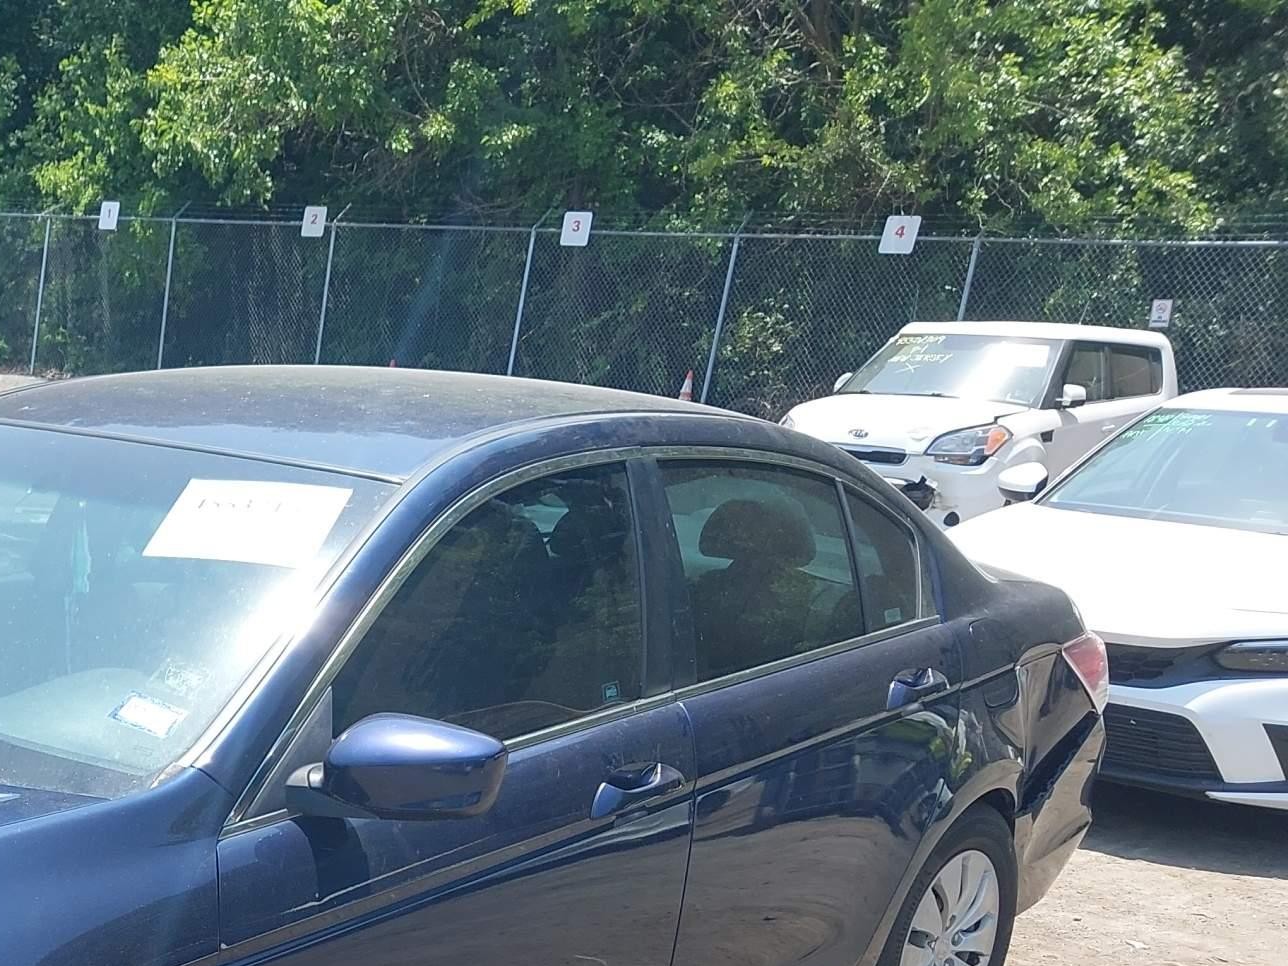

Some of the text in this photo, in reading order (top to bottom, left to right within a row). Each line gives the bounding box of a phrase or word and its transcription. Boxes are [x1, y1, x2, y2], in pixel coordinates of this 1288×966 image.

[311, 214, 319, 225] 2
[571, 220, 581, 232] 3
[895, 225, 905, 238] 4
